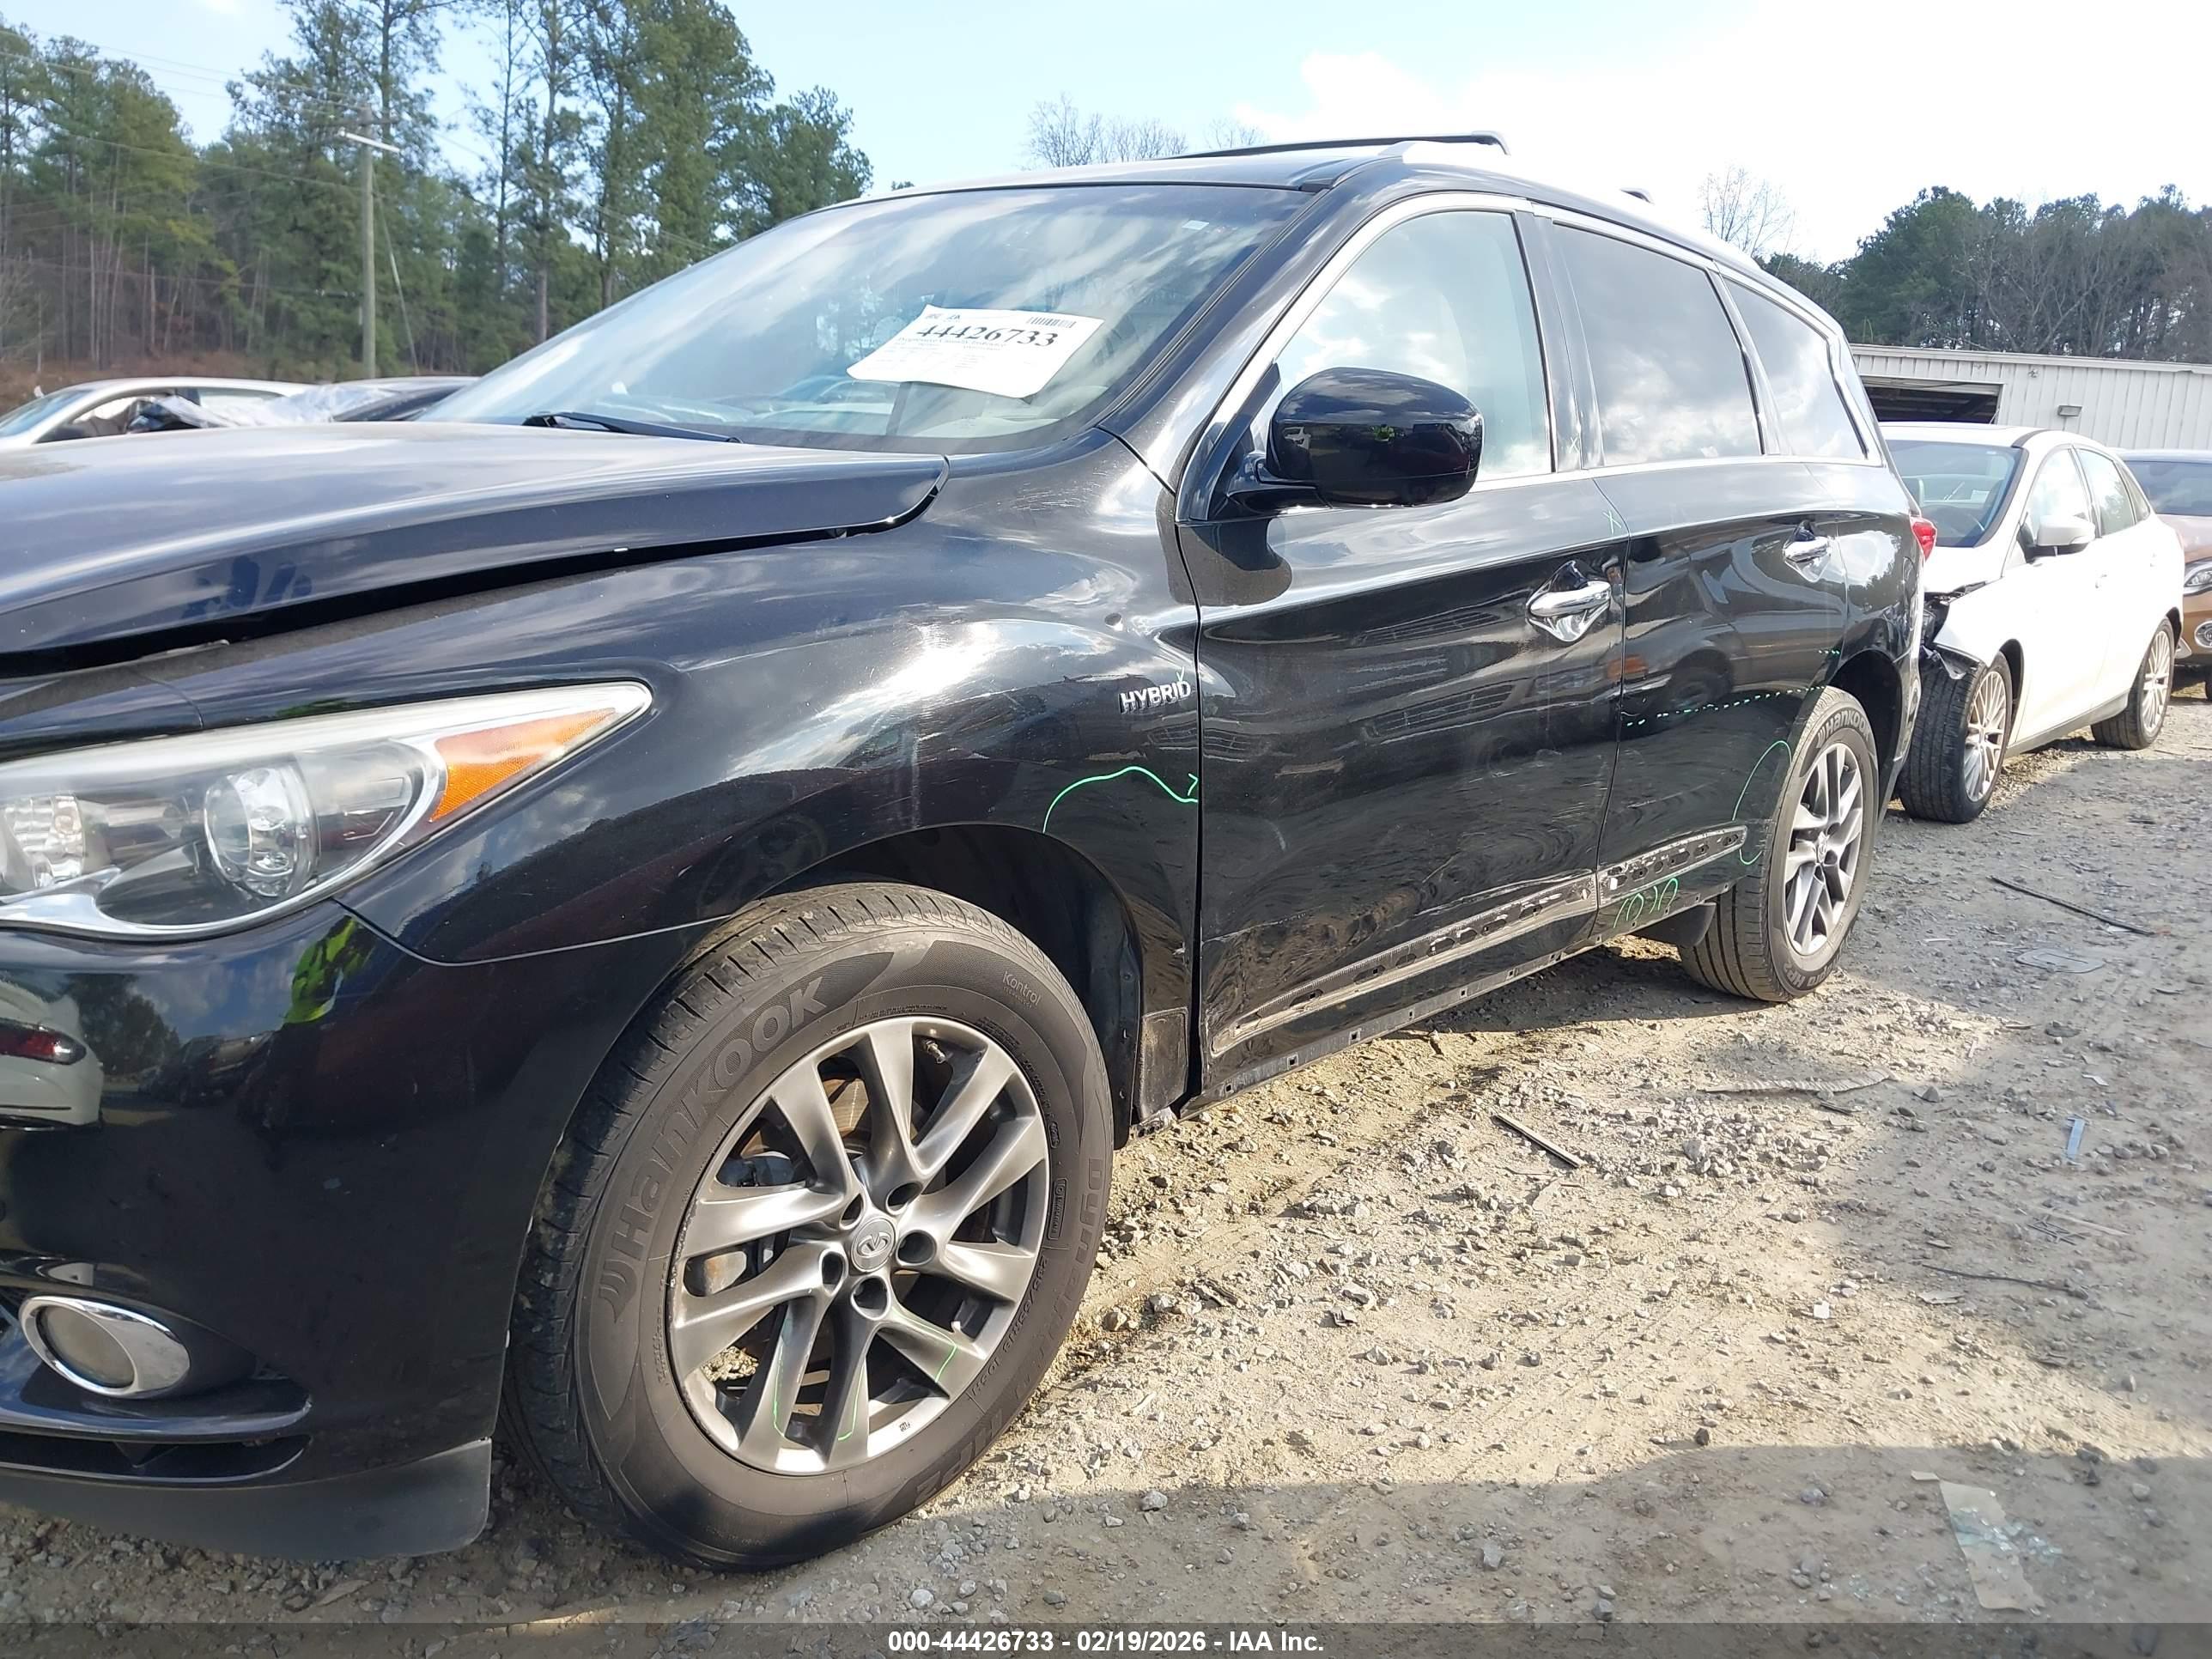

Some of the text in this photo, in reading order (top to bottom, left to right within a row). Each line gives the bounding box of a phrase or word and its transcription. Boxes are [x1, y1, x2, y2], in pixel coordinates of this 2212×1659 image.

[916, 325, 1058, 347] 44426733
[1119, 681, 1192, 712] HYBRID
[1002, 970, 1042, 1006] Kontrol
[1003, 1255, 1048, 1354] 235/65R18
